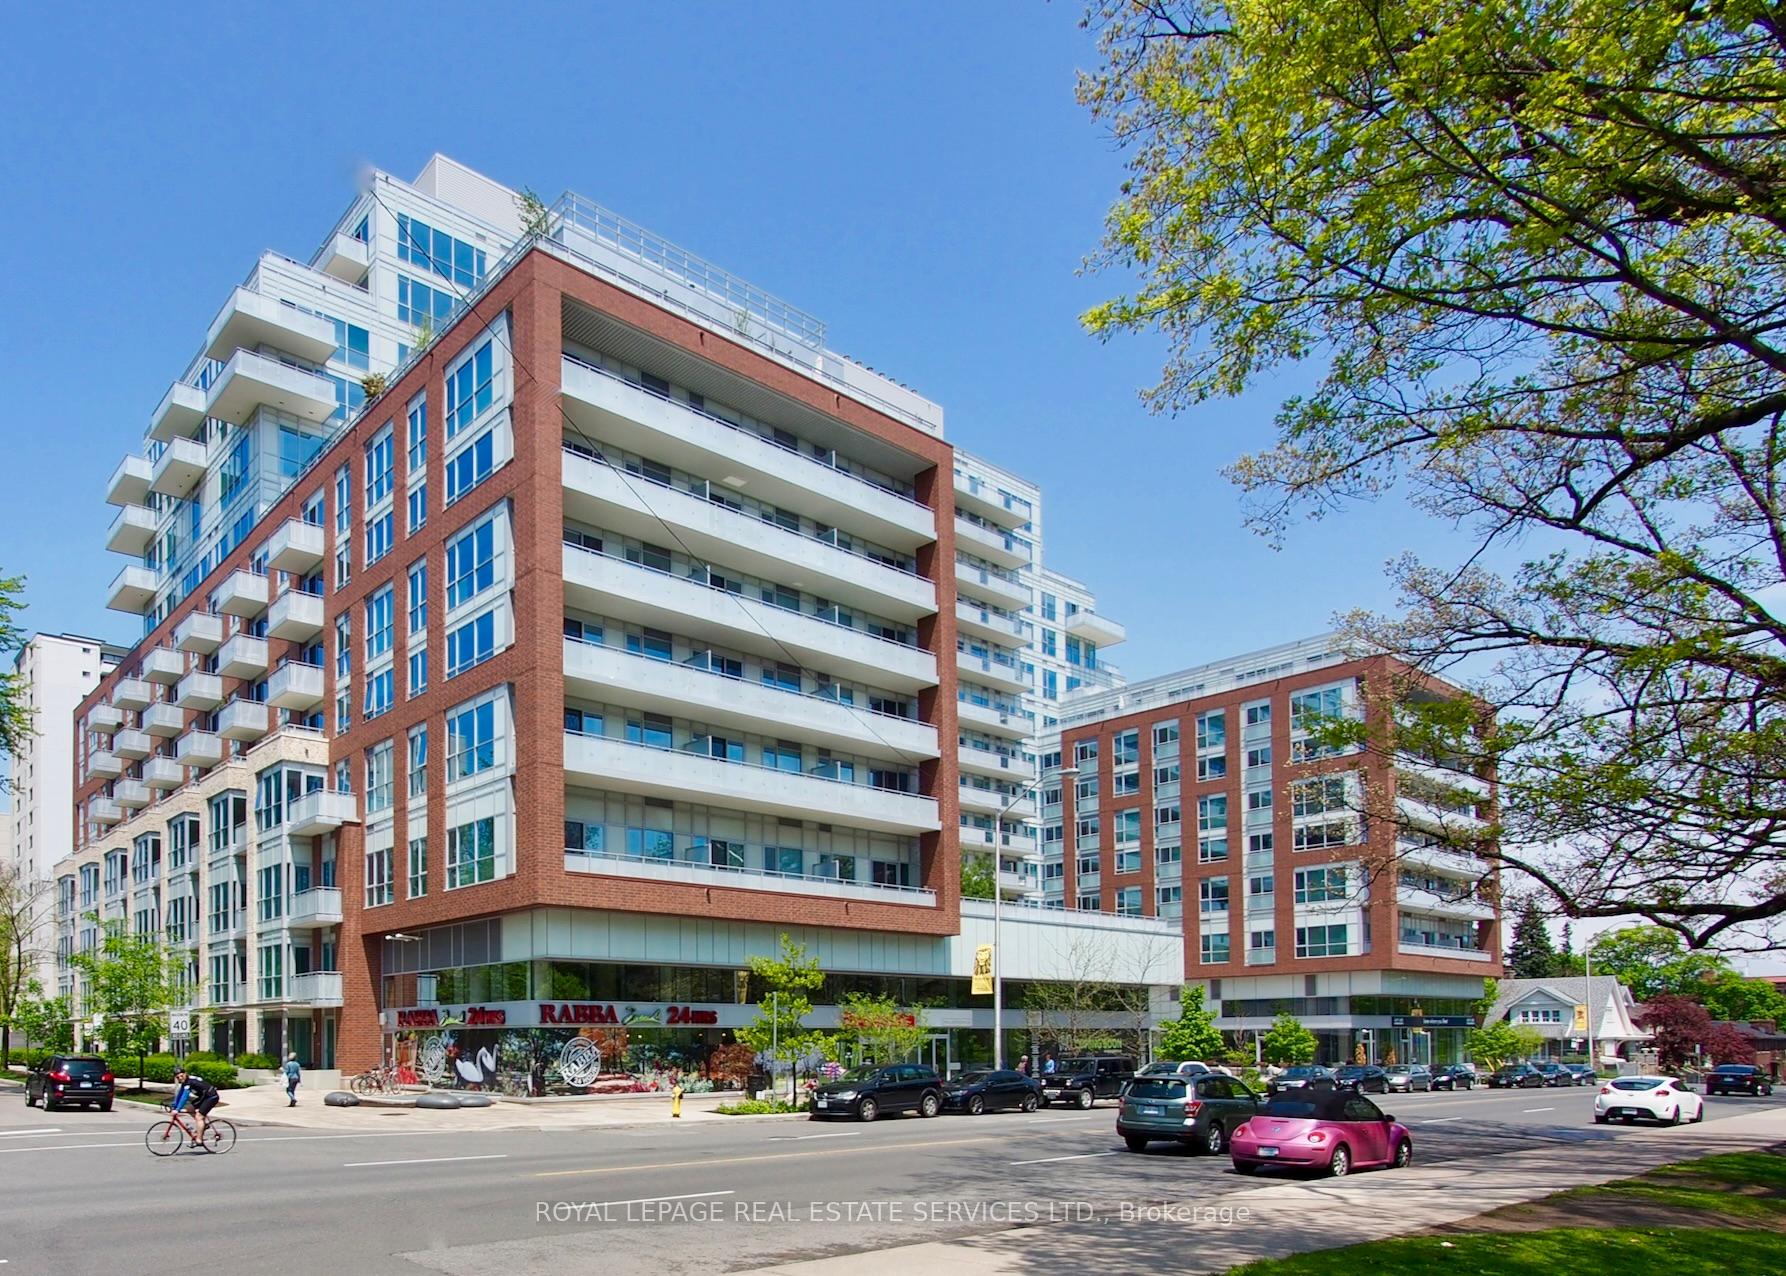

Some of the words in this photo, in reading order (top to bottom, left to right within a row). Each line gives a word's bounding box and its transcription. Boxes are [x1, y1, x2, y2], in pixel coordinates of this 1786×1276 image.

[539, 1004, 619, 1024] RABBA
[173, 1020, 188, 1030] 40
[561, 1045, 600, 1083] RABBA
